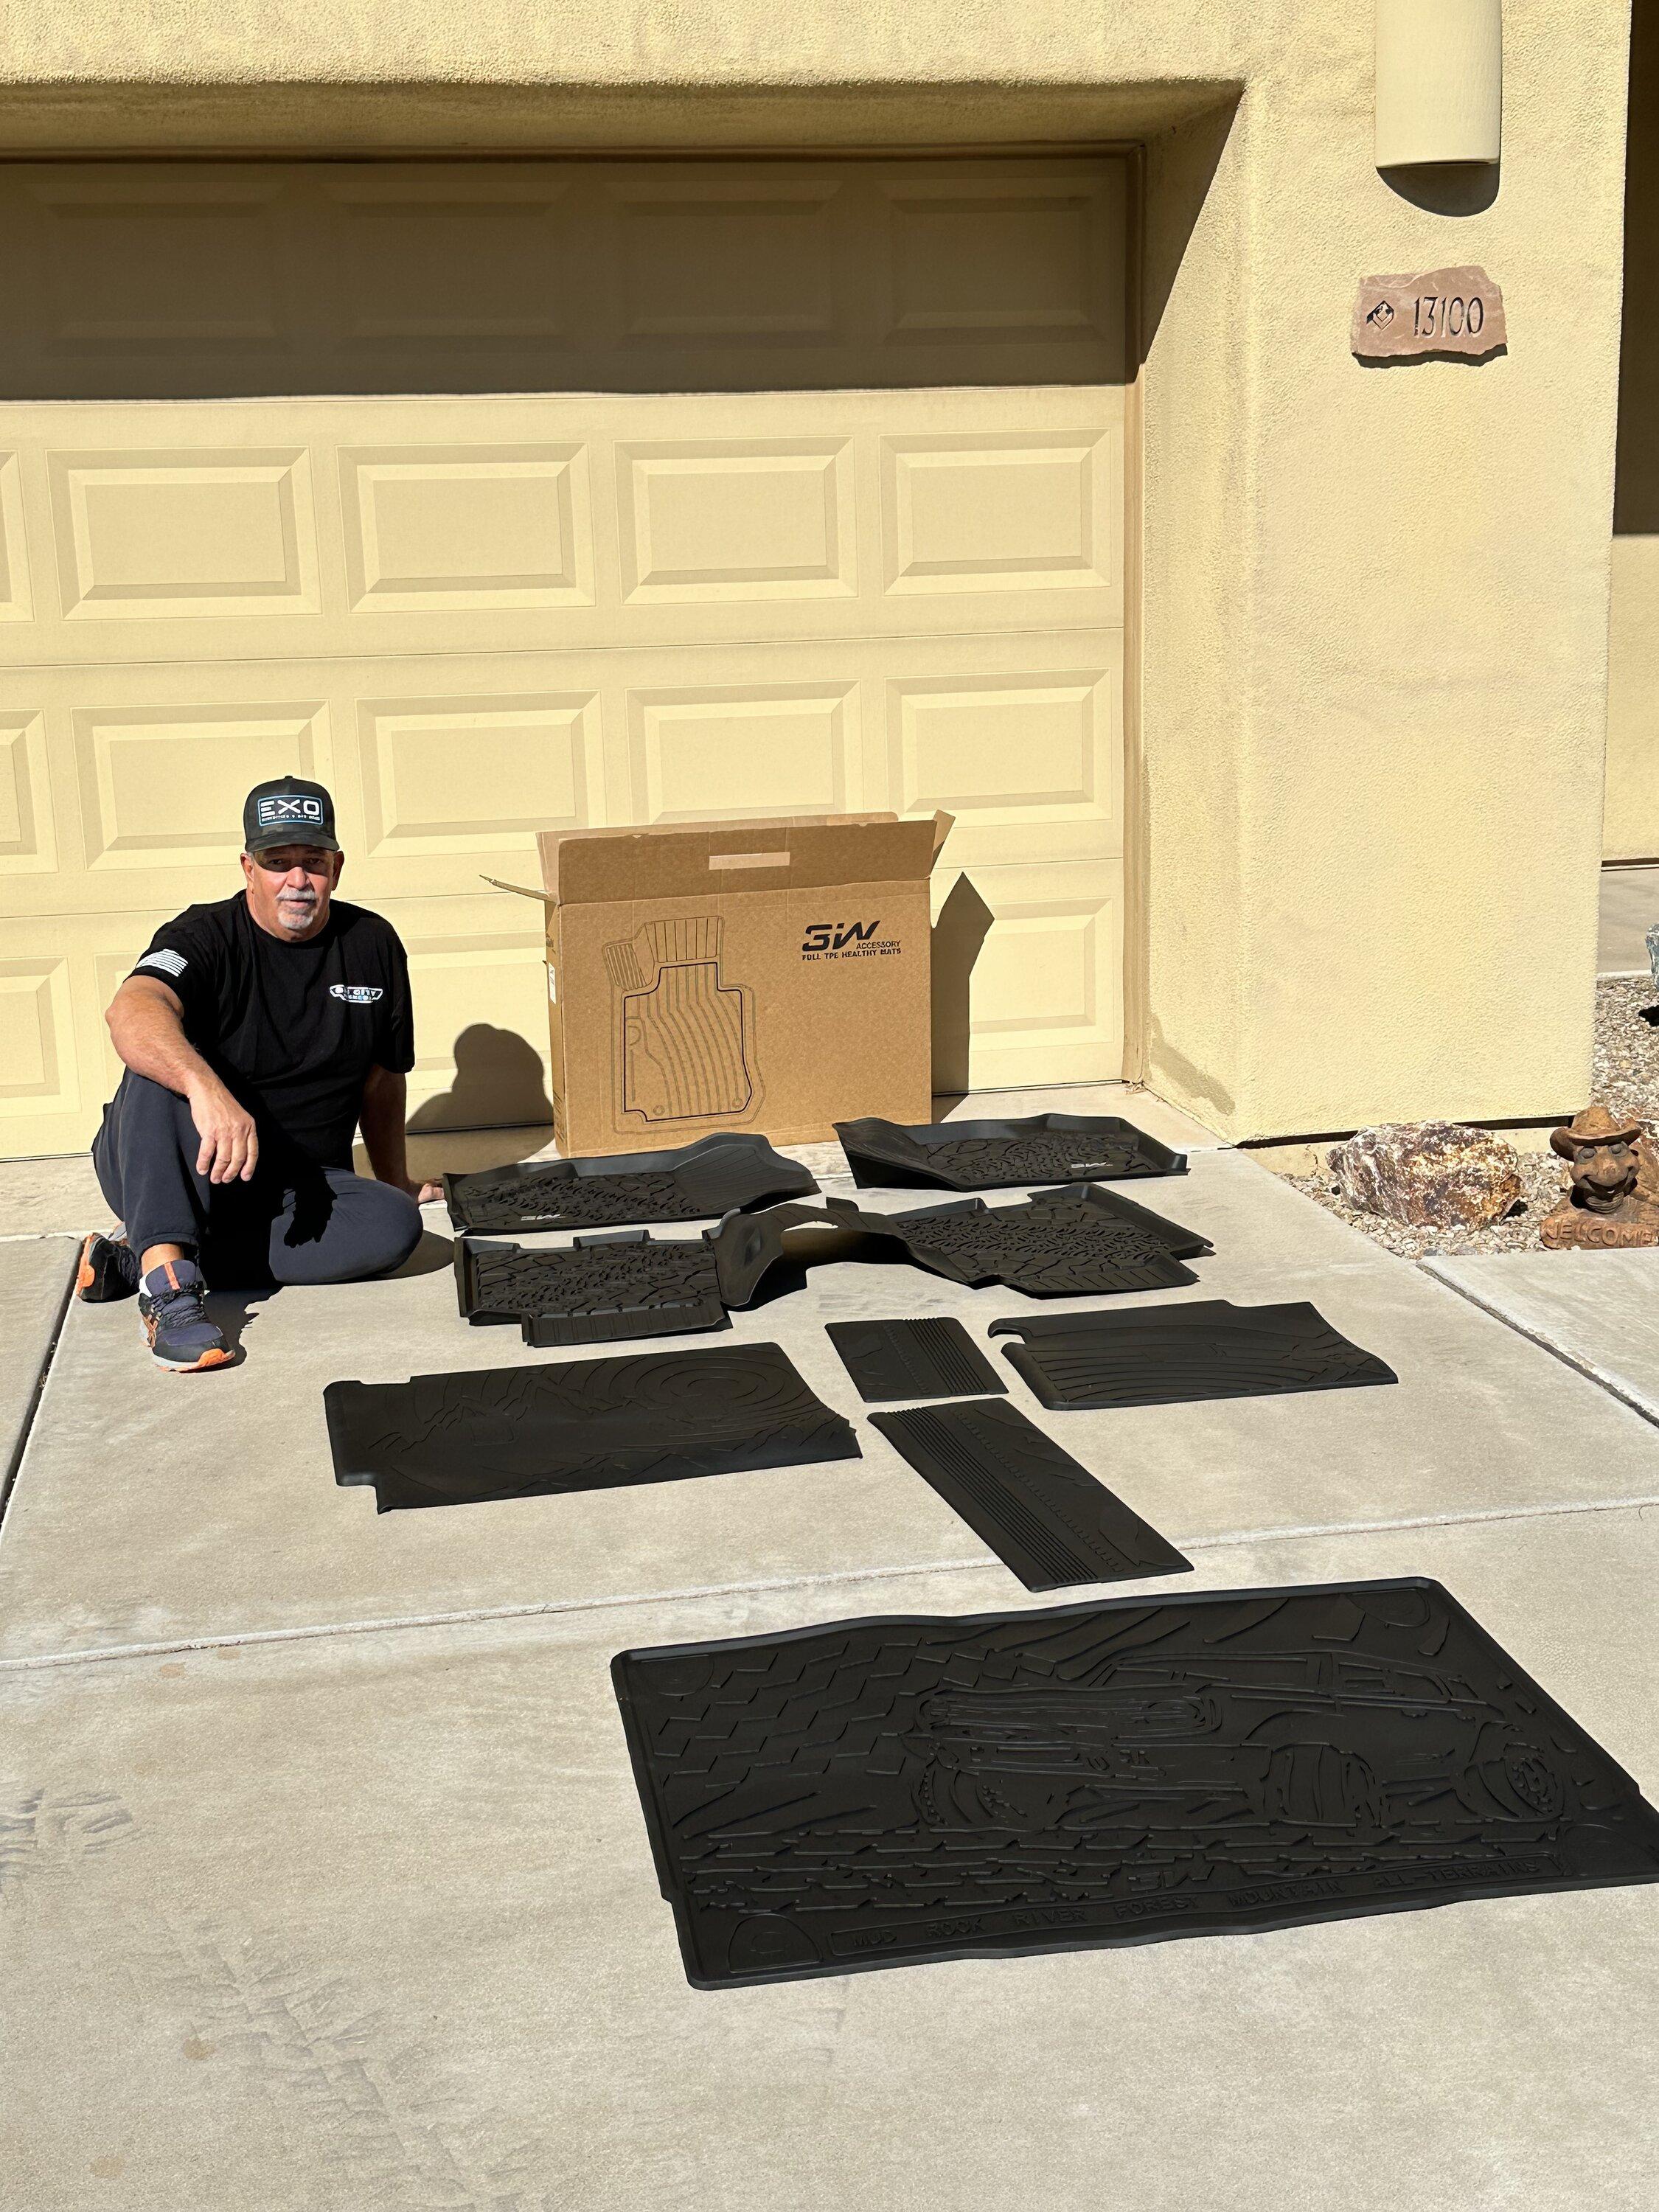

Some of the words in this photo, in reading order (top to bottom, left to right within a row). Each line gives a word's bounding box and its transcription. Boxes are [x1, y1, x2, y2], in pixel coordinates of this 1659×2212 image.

[1413, 296, 1484, 337] 13100
[260, 799, 320, 818] EXO
[841, 950, 877, 959] HEALTHY
[880, 947, 902, 956] MATS
[856, 939, 901, 950] ACCESSORY
[853, 1929, 898, 1947] MUD
[925, 1917, 987, 1939] ROCK
[1012, 1907, 1088, 1927] RIVER
[1113, 1894, 1199, 1919] FOREST
[1228, 1879, 1346, 1907] MOUNTAIN
